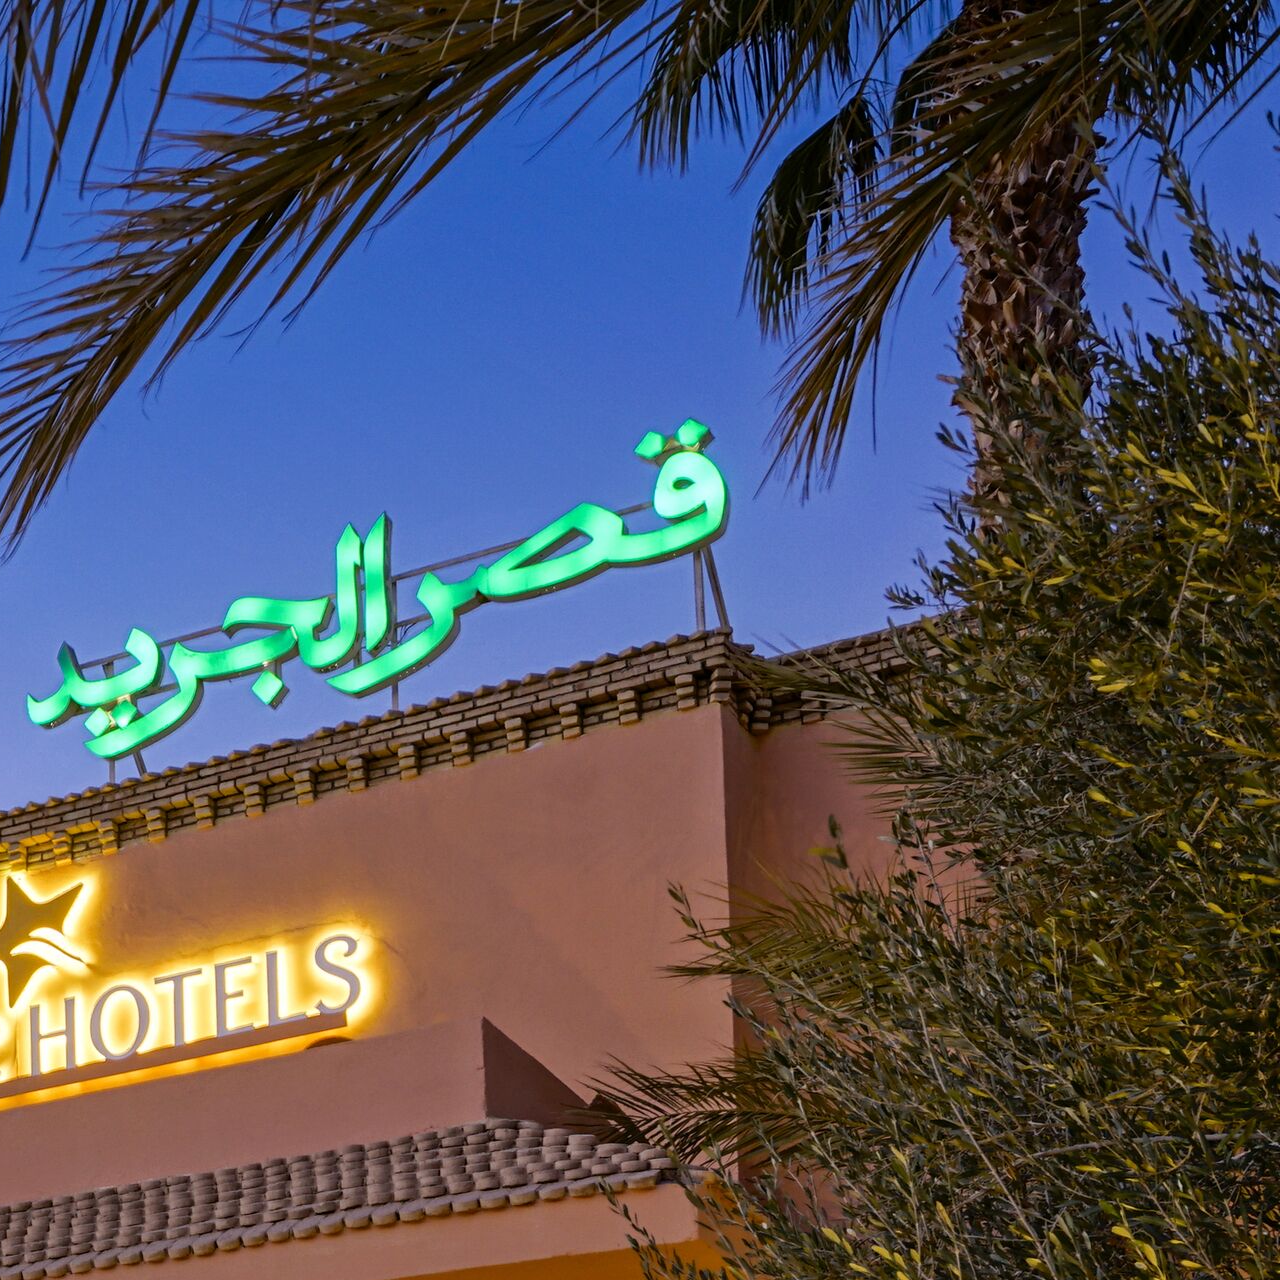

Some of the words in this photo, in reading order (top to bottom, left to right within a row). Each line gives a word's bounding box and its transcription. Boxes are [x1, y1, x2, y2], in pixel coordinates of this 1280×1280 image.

[26, 511, 393, 759] الجريد
[327, 418, 730, 698] قصر
[28, 934, 363, 1078] HOTELS
